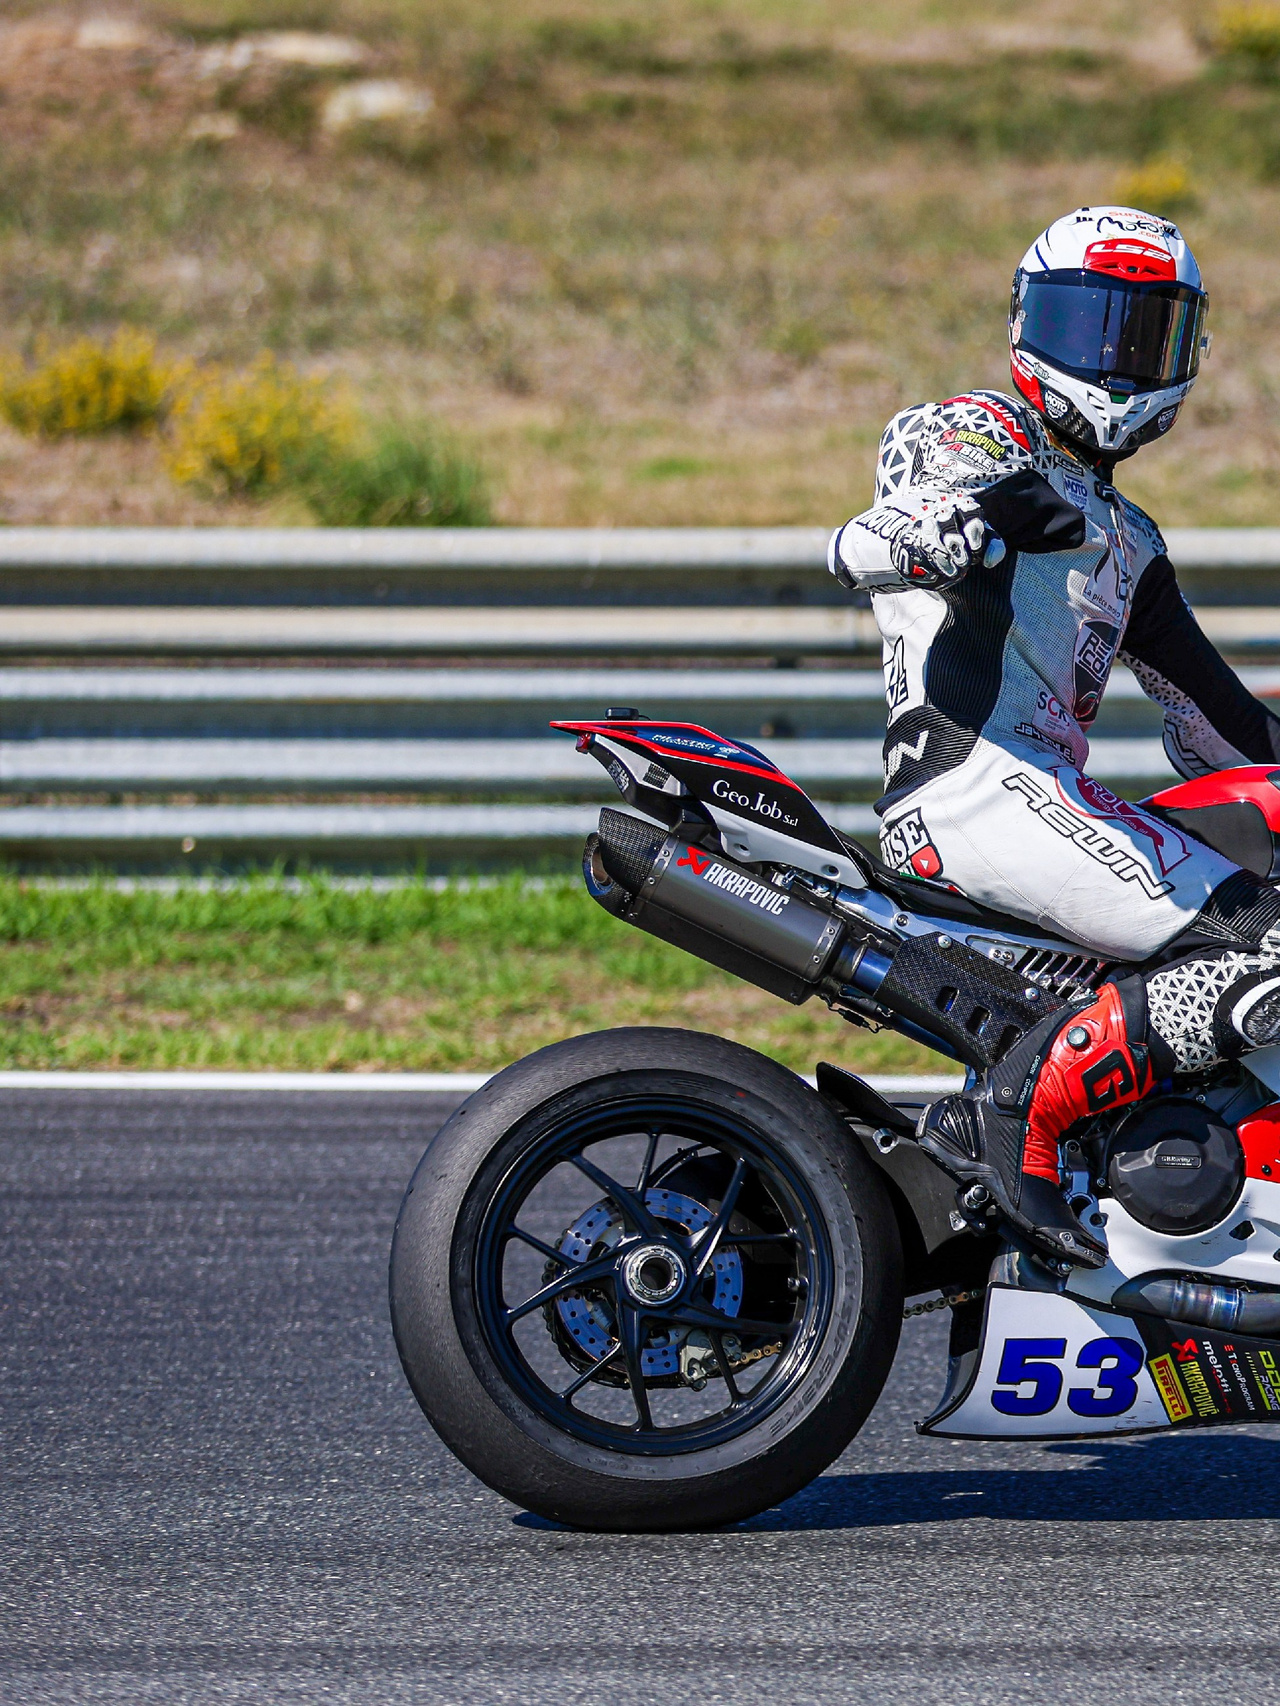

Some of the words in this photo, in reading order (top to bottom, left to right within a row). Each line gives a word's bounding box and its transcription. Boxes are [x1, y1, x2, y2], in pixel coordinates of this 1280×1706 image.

[1090, 244, 1172, 263] LS2
[1046, 393, 1068, 413] MOTO
[1065, 479, 1088, 496] MOTO
[712, 779, 749, 806] Geo
[750, 791, 782, 820] Job
[1085, 779, 1124, 815] RDL
[1001, 772, 1176, 900] REWIN
[990, 1336, 1144, 1418] 53
[1154, 1358, 1188, 1417] PIRELLI
[1260, 1375, 1280, 1411] RACING
